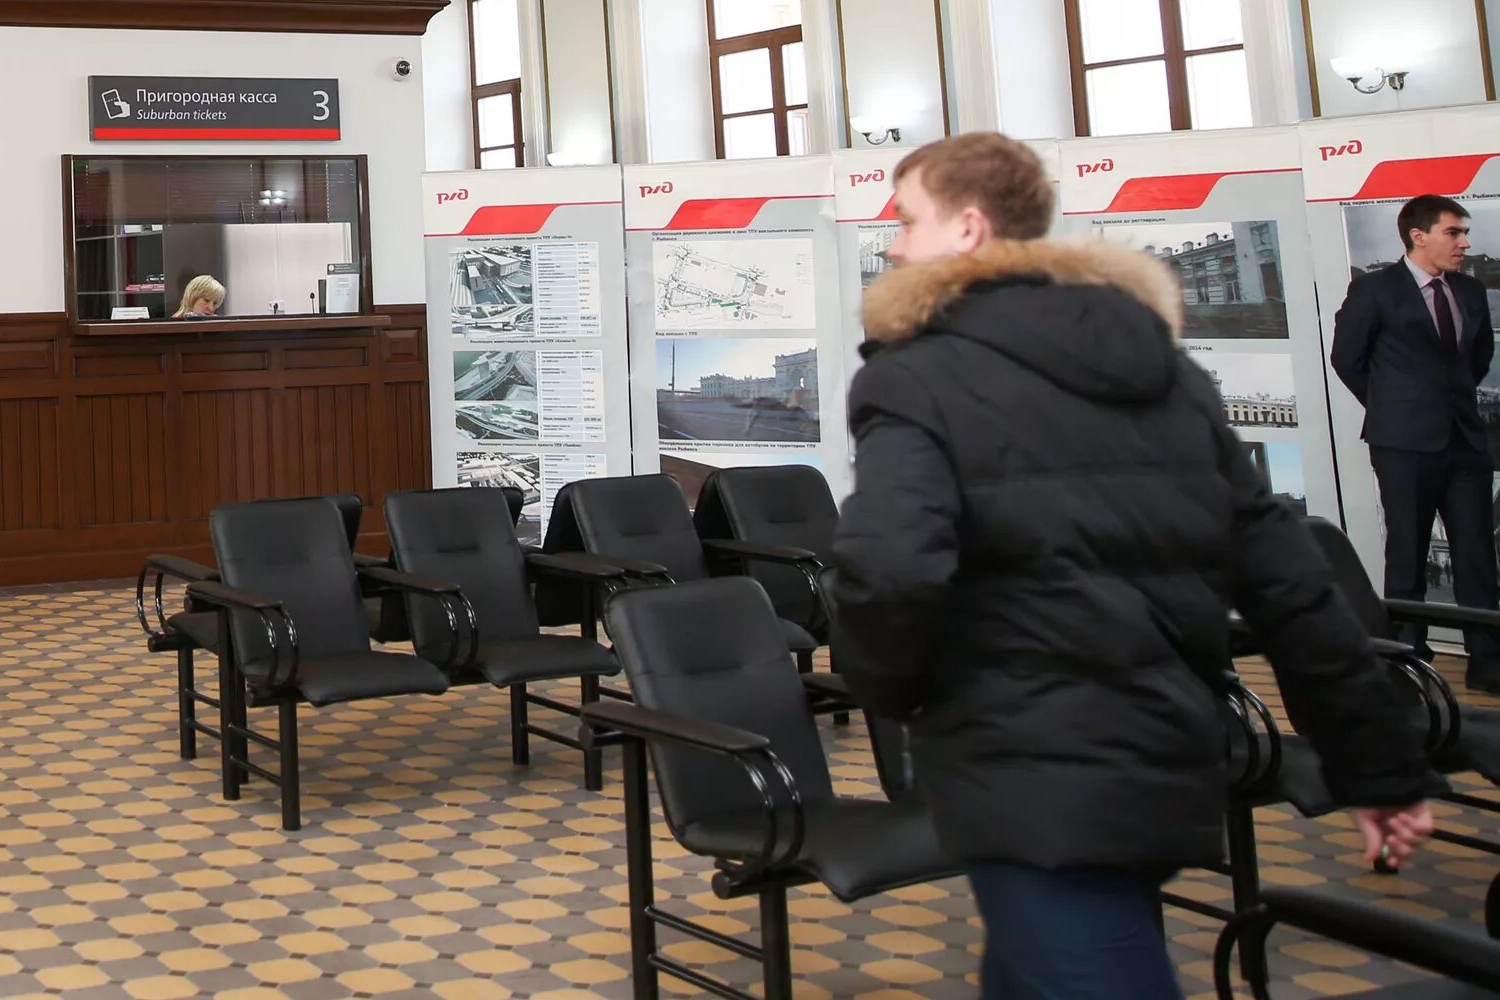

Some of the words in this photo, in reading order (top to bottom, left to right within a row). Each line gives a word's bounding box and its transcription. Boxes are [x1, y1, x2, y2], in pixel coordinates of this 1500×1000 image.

[136, 88, 236, 106] Пригородная
[239, 92, 278, 104] касса
[312, 90, 331, 121] 3
[136, 109, 191, 121] Suburban
[193, 110, 227, 121] tickets
